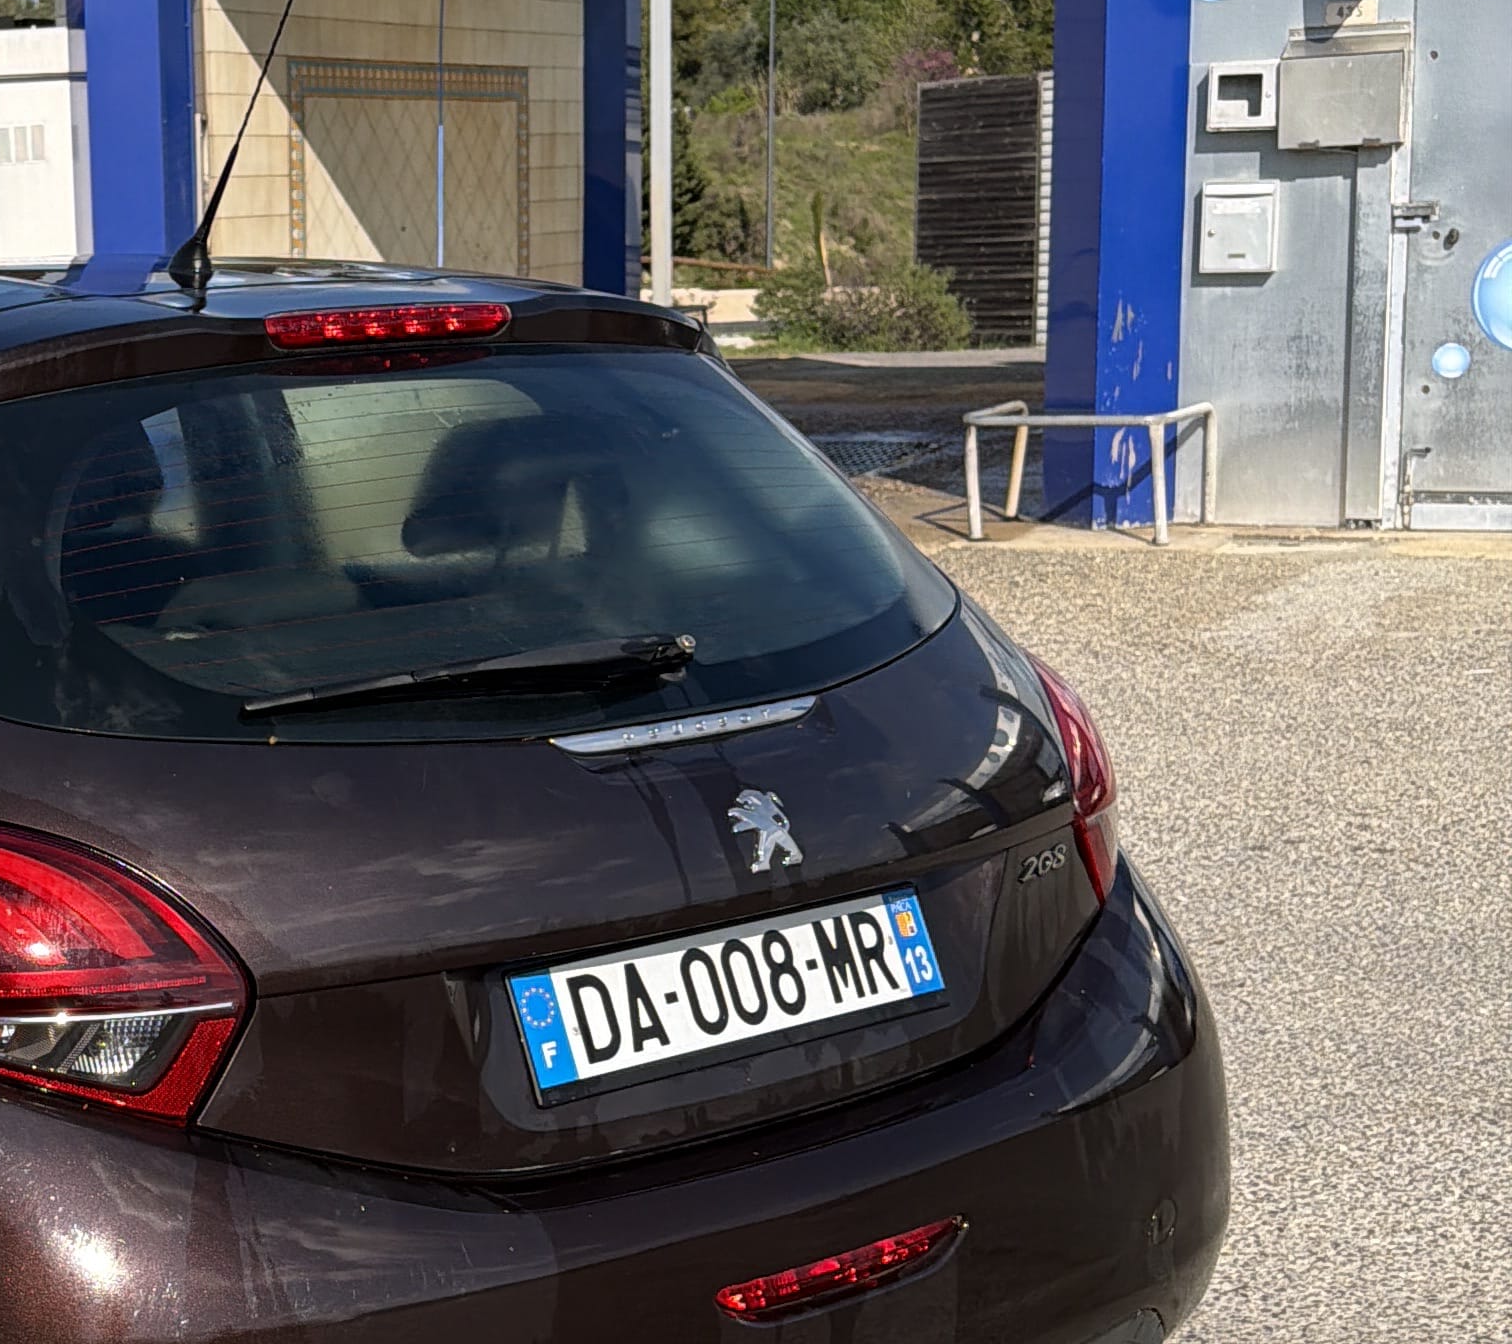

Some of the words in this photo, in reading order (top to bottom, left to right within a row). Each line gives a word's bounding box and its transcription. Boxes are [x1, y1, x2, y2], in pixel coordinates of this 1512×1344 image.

[1017, 843, 1067, 884] 208
[905, 944, 934, 984] 13
[566, 910, 901, 1065] DA-008-MR
[540, 1041, 558, 1070] F
